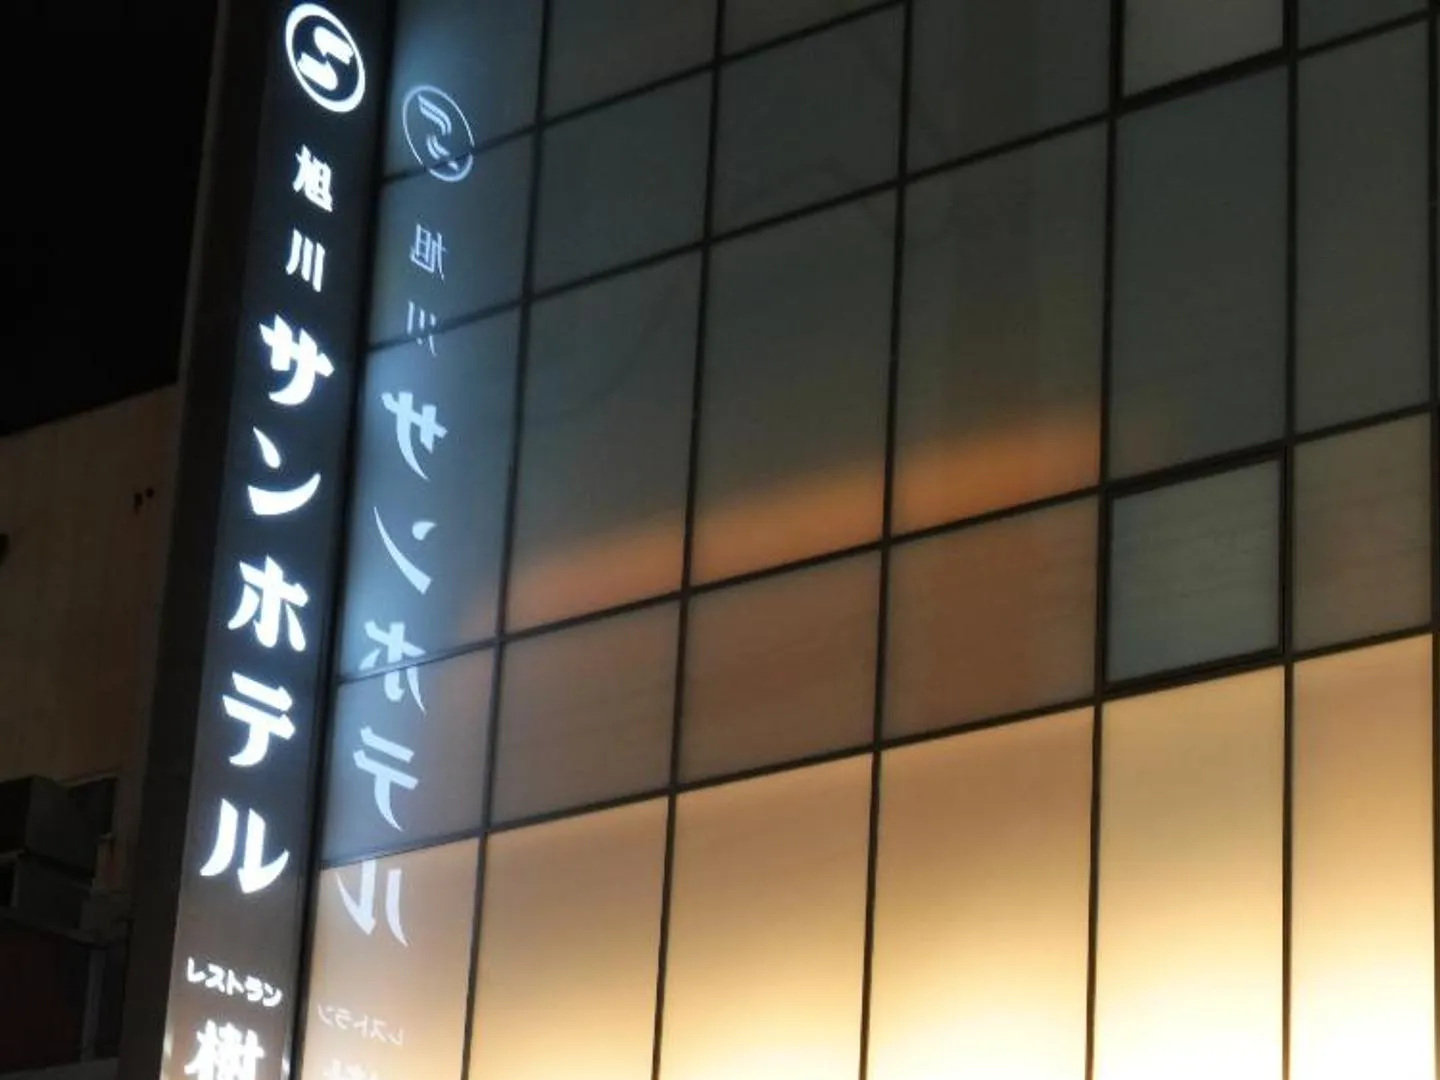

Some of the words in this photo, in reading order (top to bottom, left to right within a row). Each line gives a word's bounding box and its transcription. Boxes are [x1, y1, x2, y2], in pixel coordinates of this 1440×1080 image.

[187, 957, 282, 1007] レストラン
